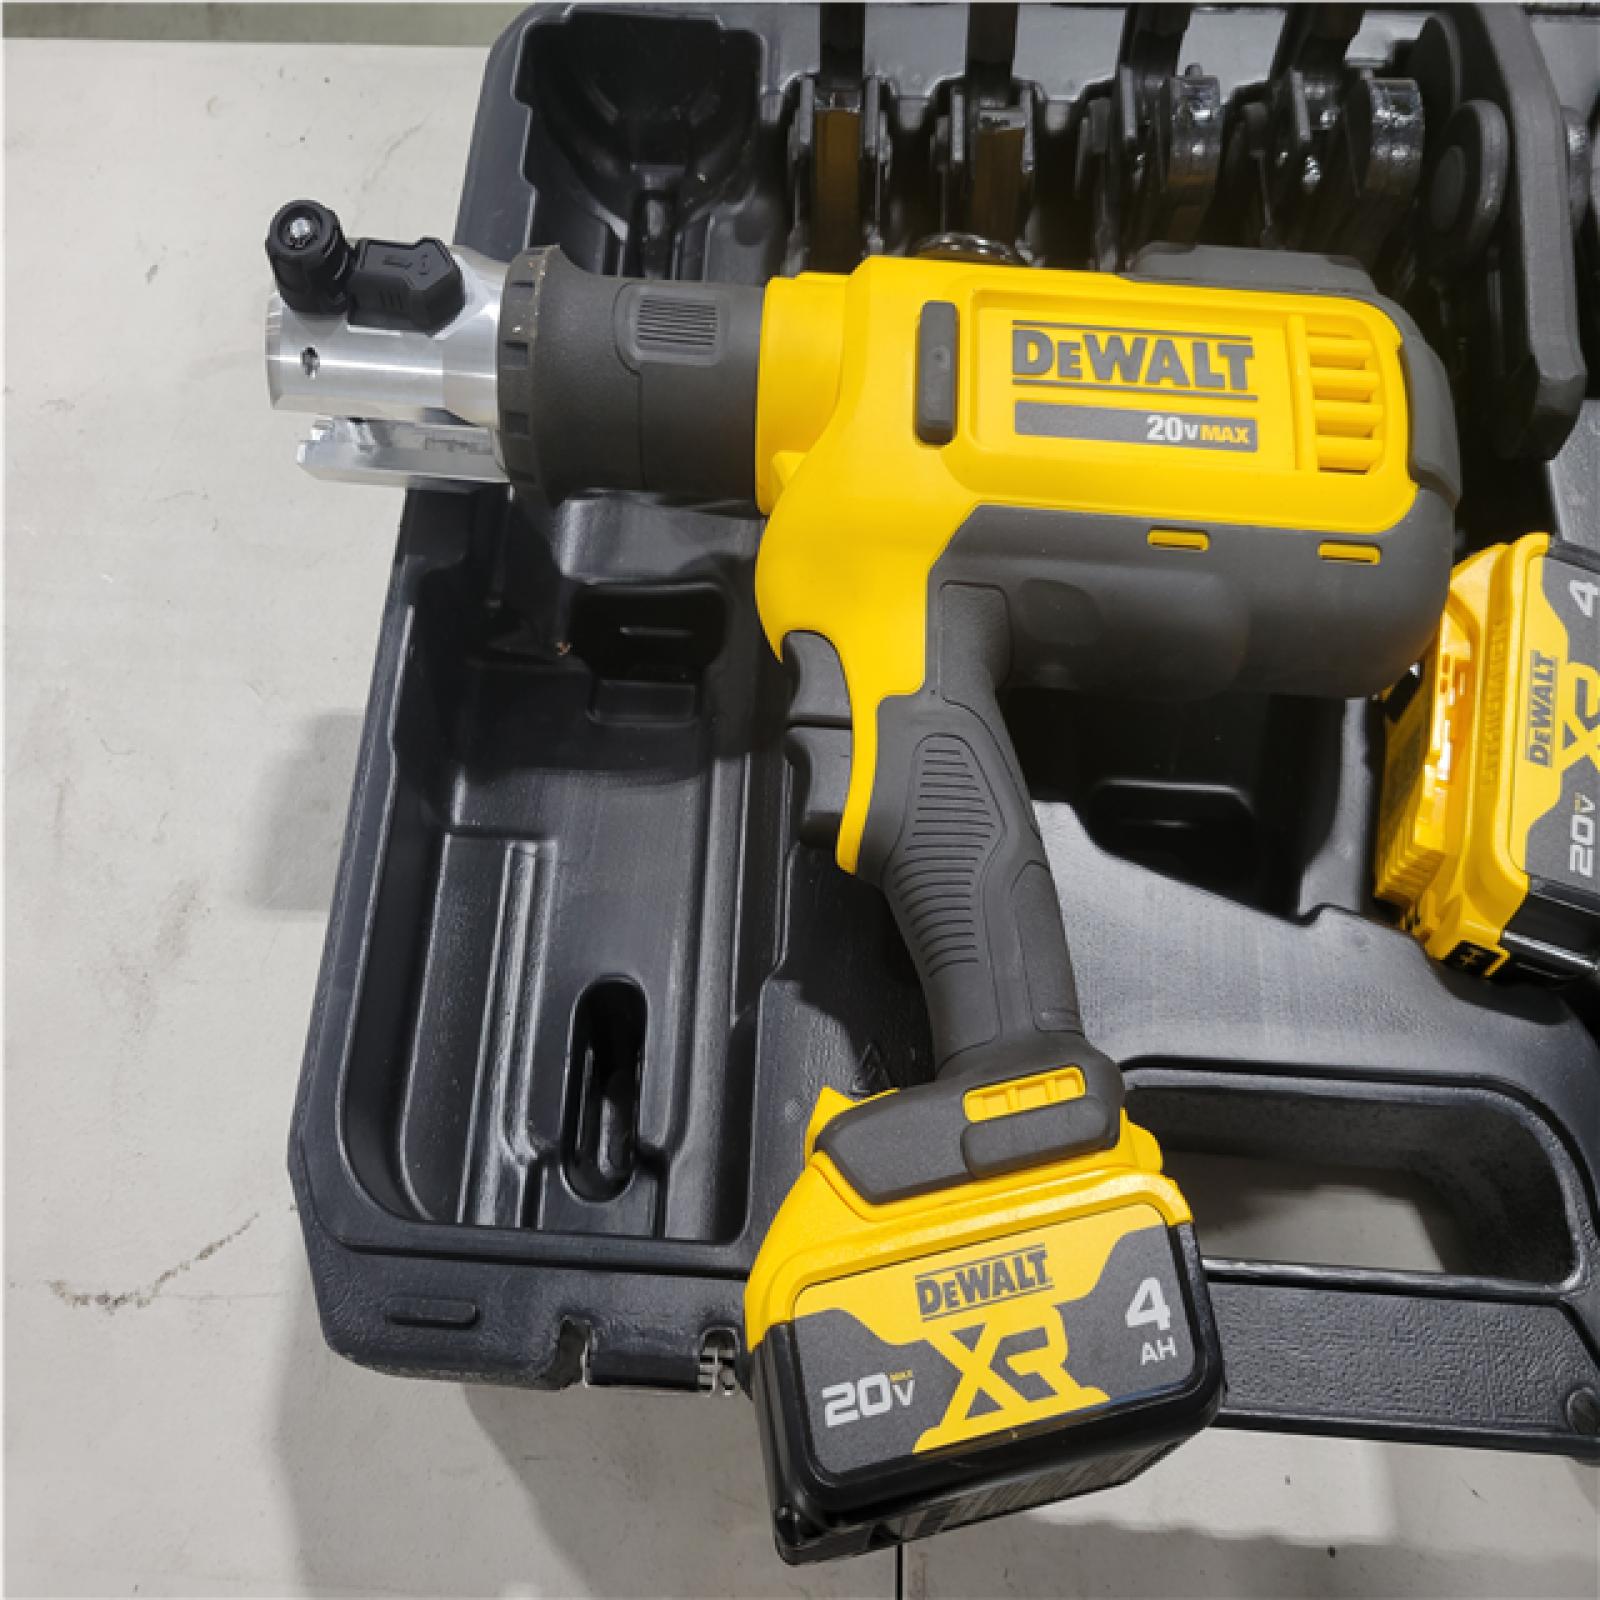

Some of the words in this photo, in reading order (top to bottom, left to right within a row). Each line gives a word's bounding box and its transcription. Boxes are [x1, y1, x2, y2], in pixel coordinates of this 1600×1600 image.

[1012, 329, 1254, 390] DEWALT
[1201, 424, 1249, 443] MAX
[1569, 579, 1600, 618] 4
[1530, 650, 1554, 766] DEWALT
[917, 1250, 1047, 1315] DEWALT
[1125, 1276, 1171, 1331] 4
[1141, 1336, 1177, 1366] AH
[912, 1308, 1111, 1453] XR
